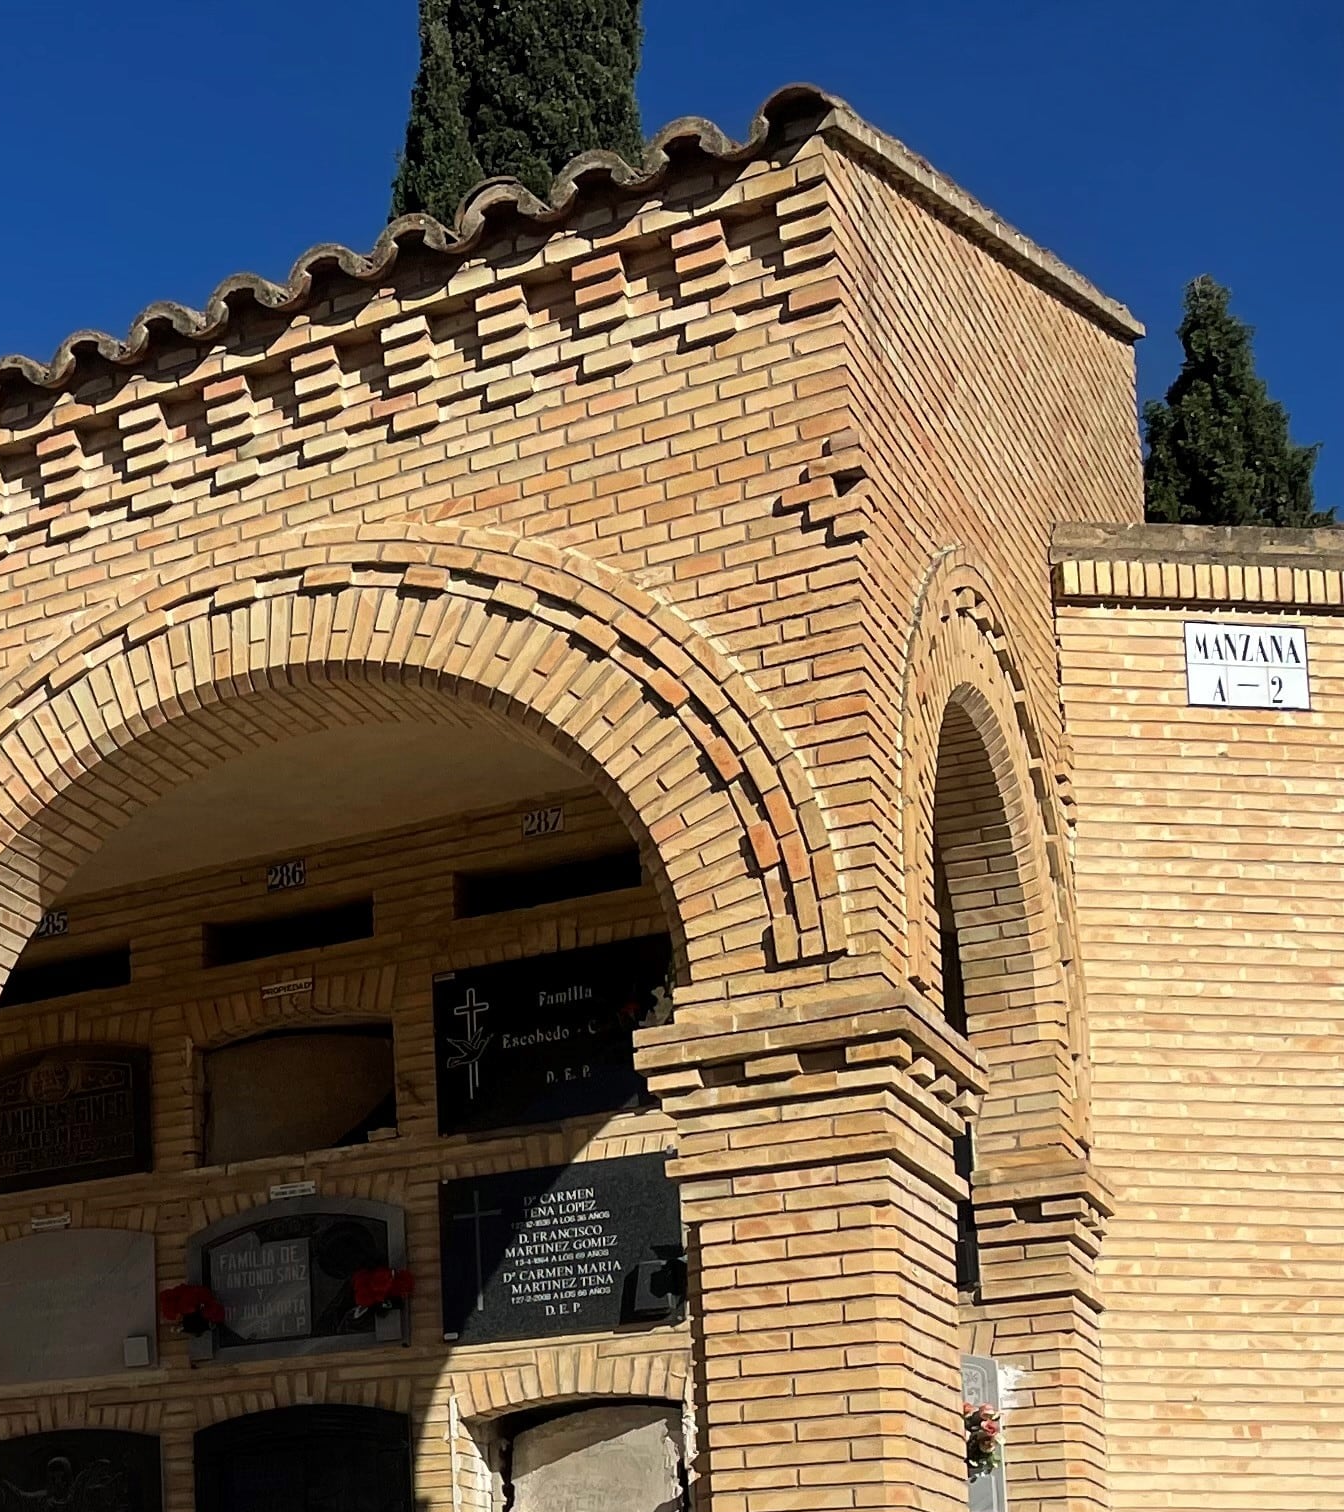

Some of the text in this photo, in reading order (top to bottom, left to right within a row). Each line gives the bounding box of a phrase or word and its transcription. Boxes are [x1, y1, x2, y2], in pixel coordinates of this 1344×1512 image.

[1194, 632, 1301, 664] MANZANA
[1213, 675, 1284, 704] A 2
[523, 809, 562, 835] 287
[269, 862, 305, 889] 286
[540, 1187, 594, 1205] CARMEN
[522, 1200, 596, 1220] TENA LOPEZ
[533, 1224, 602, 1243] FRANCISCO
[505, 1235, 618, 1258] MARTINEZ GOMEZ
[220, 1245, 299, 1272] FAMILIA DE
[226, 1269, 274, 1288] ANTONIO
[519, 1265, 573, 1281] CARMEN
[577, 1260, 622, 1275] MARIA
[512, 1274, 614, 1294] MARTINEZ TENA
